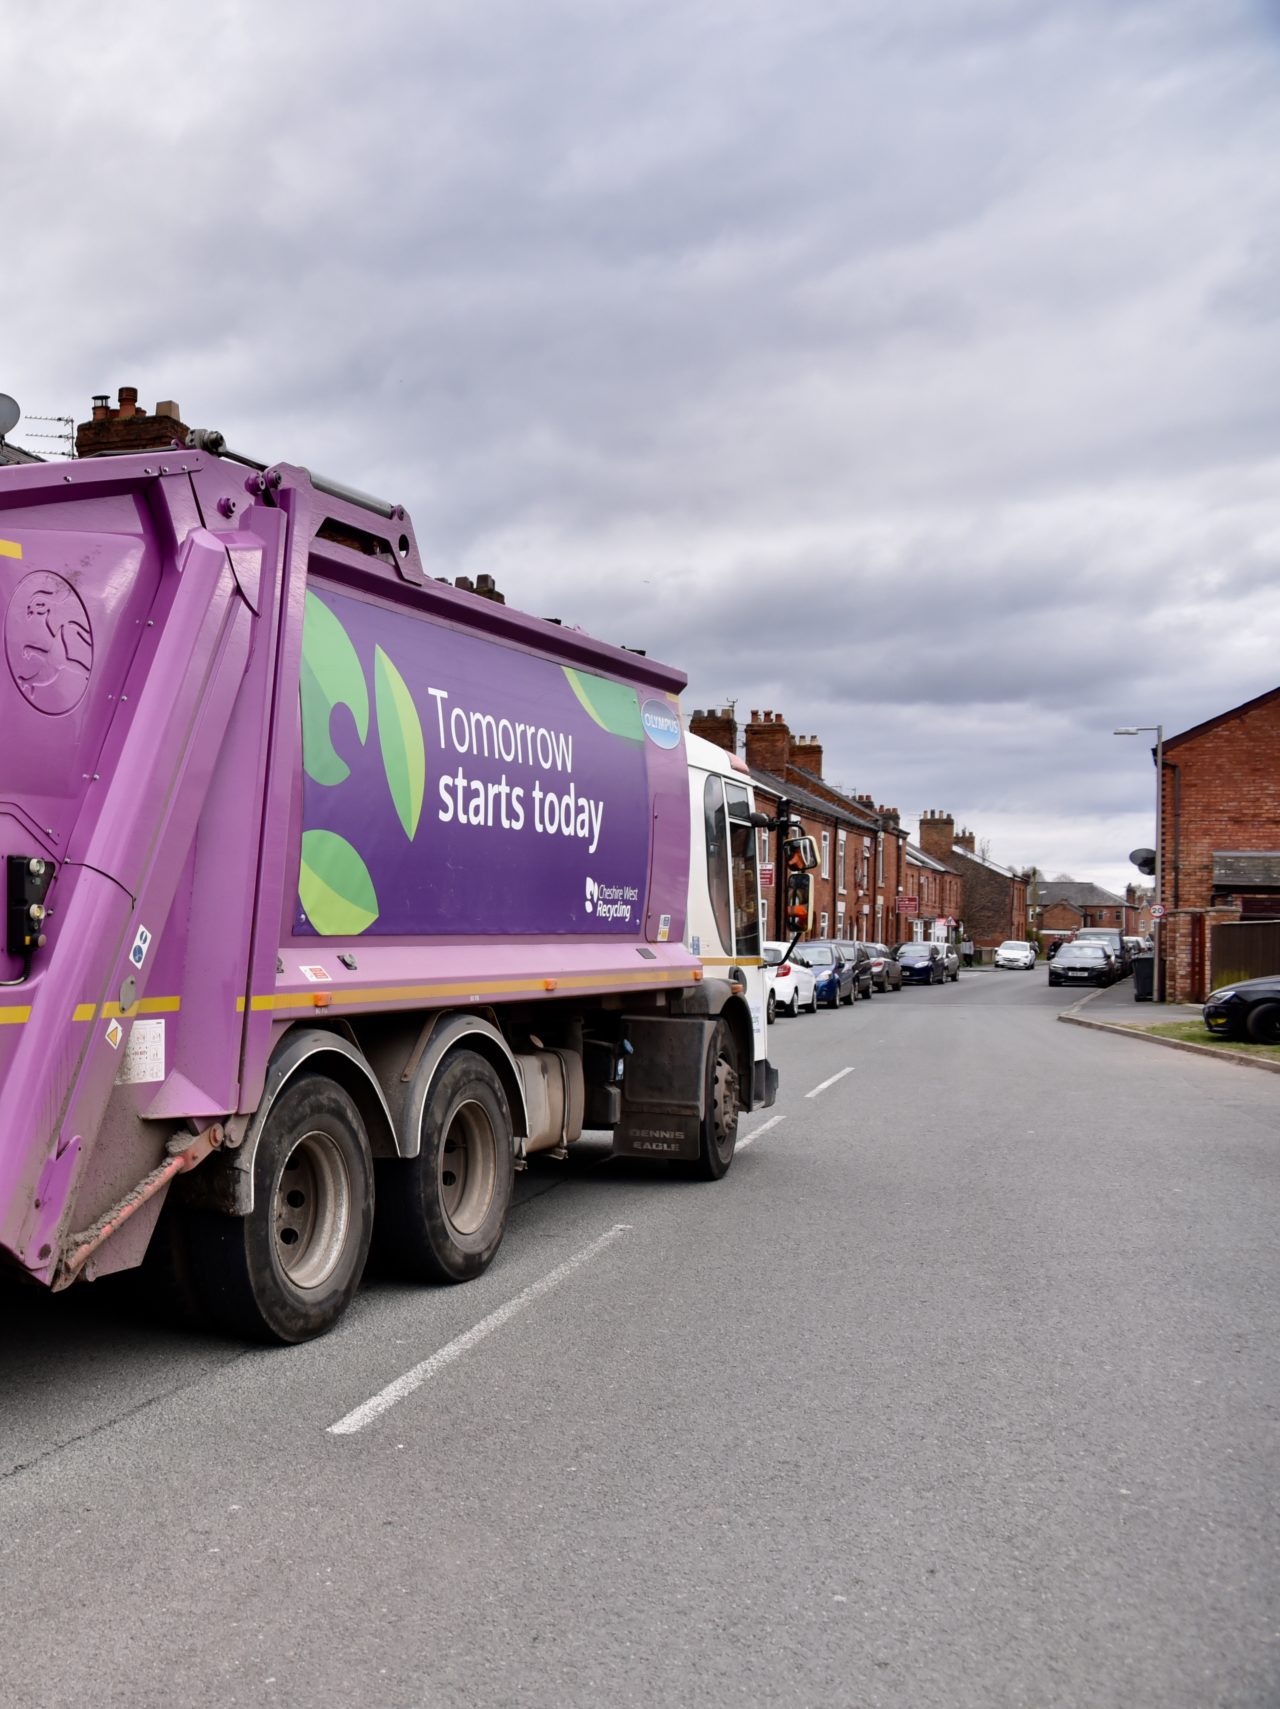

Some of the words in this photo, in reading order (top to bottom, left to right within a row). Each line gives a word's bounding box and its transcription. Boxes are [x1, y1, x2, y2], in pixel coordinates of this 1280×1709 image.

[427, 687, 573, 773] Tomorrow
[644, 713, 678, 734] OLYMPUS
[438, 767, 525, 830] starts
[532, 780, 603, 854] today
[598, 884, 623, 899] Cheshire
[624, 886, 638, 901] West
[596, 900, 631, 922] Recycling
[629, 1129, 685, 1139] DENNIS
[632, 1141, 681, 1151] EAGLE
